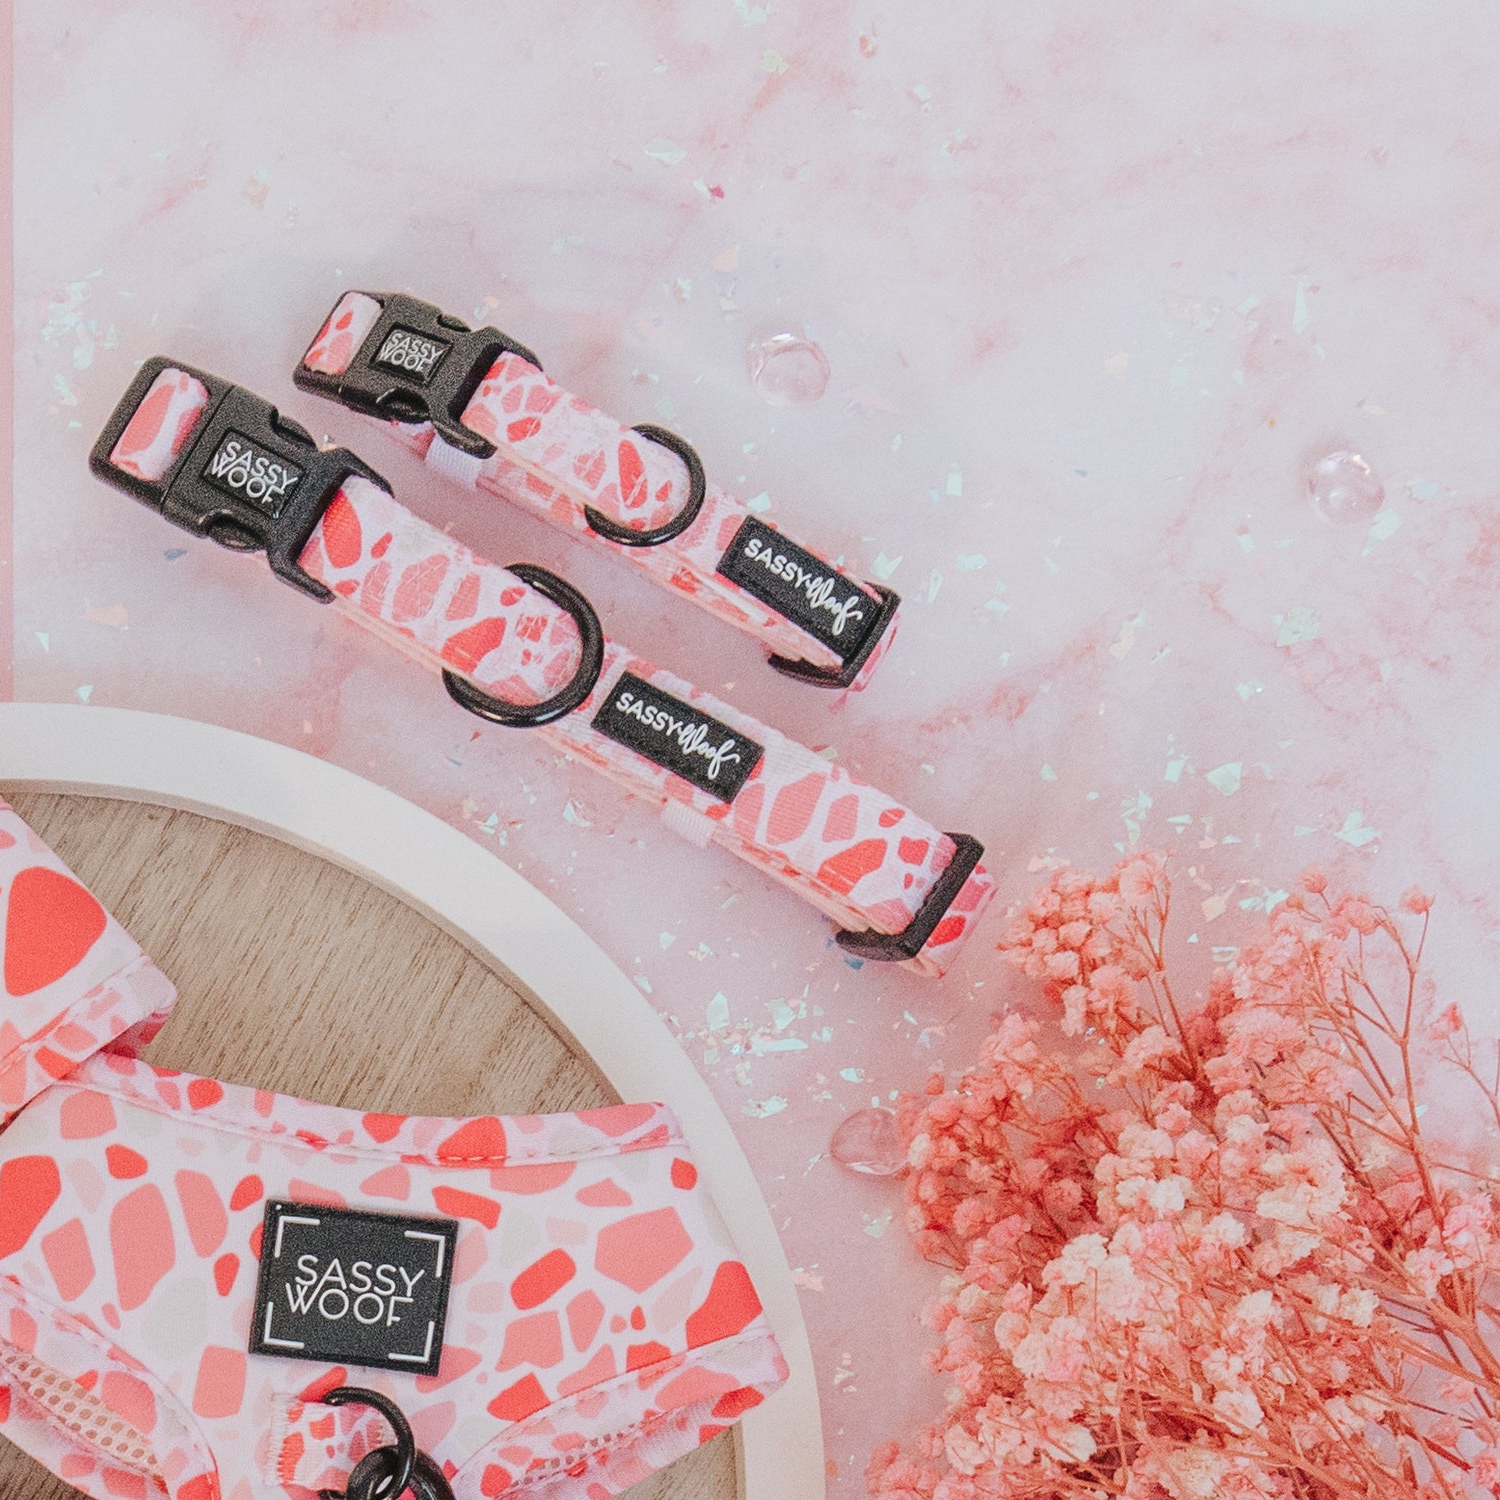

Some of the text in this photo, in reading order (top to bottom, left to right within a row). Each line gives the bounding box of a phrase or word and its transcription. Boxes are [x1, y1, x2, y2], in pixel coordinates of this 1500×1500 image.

[379, 343, 433, 372] WOOF
[389, 333, 443, 361] SASSY
[211, 452, 285, 504] WOOF
[225, 441, 298, 491] SASSY
[744, 538, 811, 589] SASSY
[616, 692, 741, 780] SASSY Woof
[295, 1254, 425, 1297] SASSY
[285, 1282, 414, 1327] WOOF
